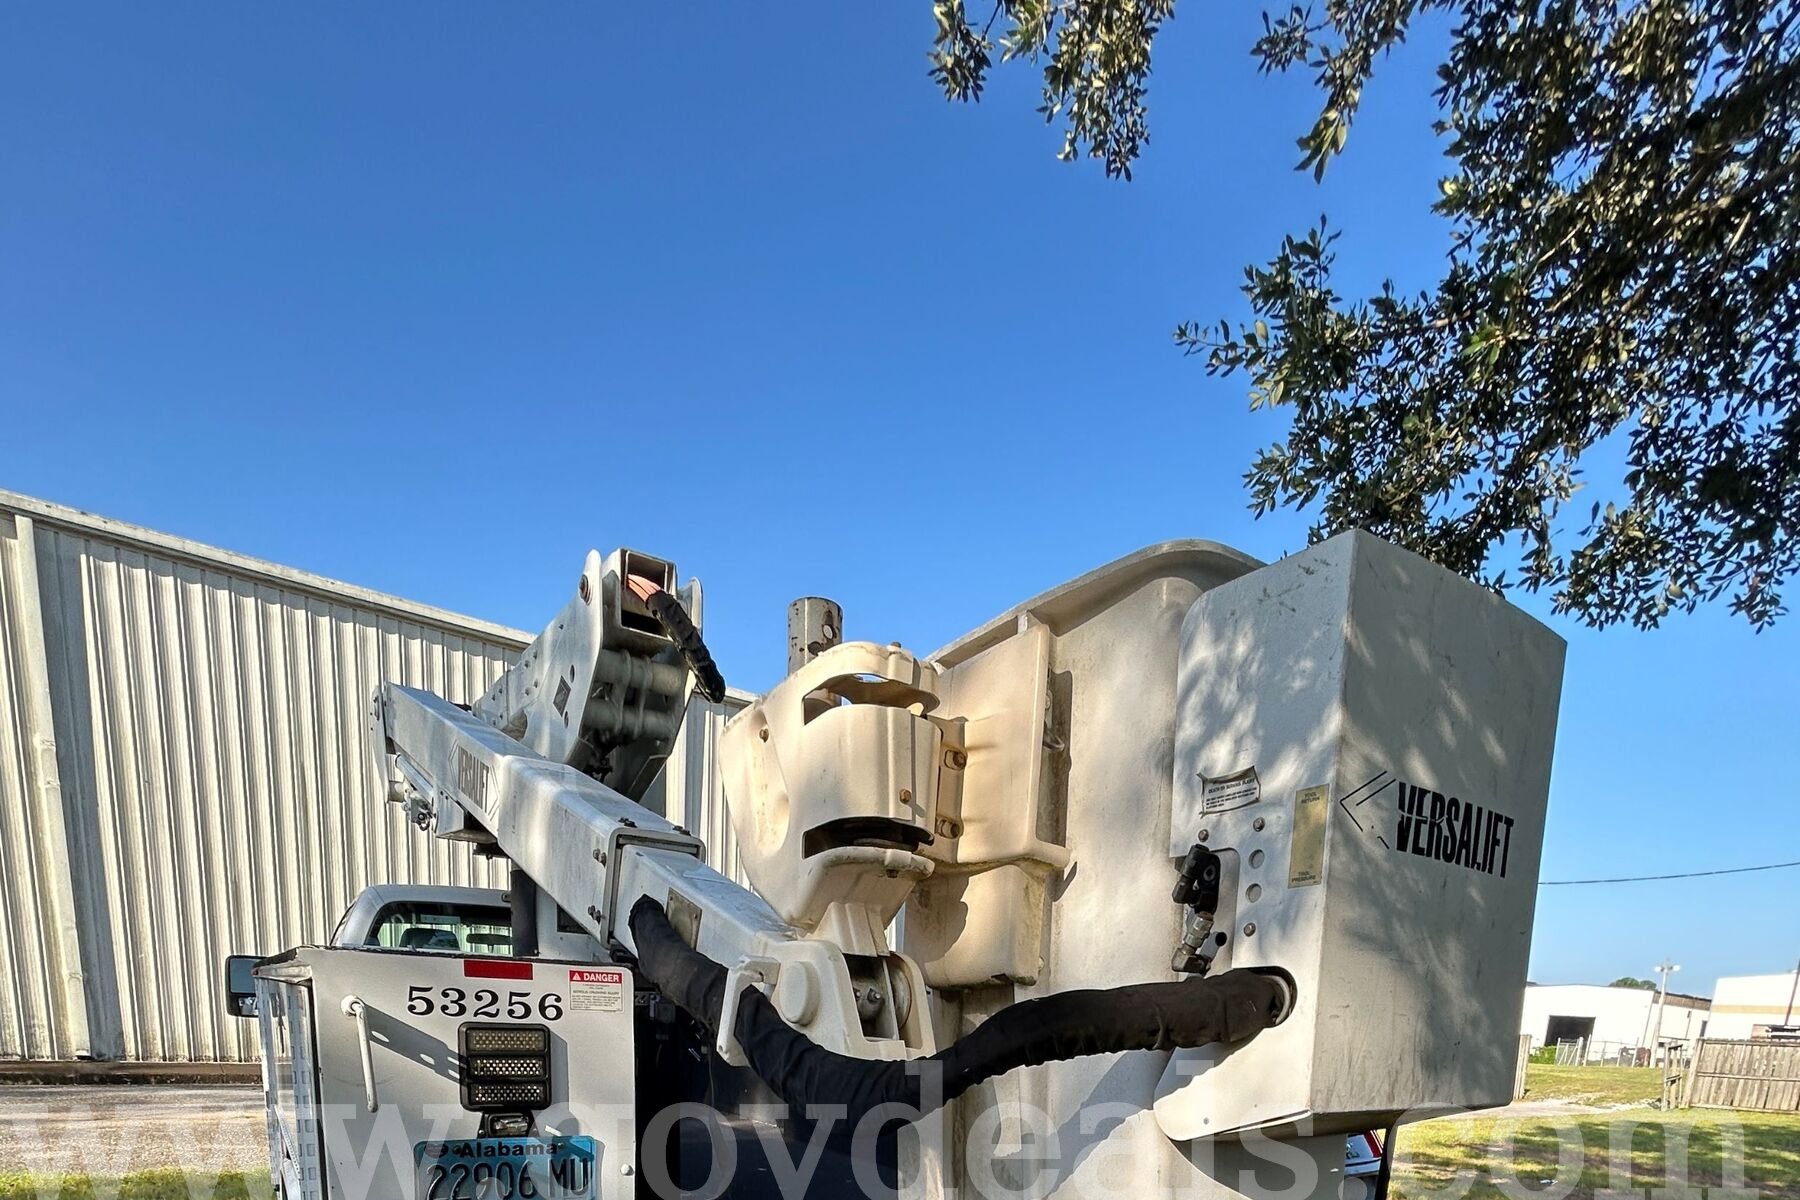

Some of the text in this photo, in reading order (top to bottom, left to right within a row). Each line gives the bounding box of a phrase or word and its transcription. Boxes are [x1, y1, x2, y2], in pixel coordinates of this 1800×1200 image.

[1396, 781, 1514, 878] VERSALIFT
[583, 972, 620, 983] DANGER
[407, 985, 564, 1021] 53256
[461, 1141, 557, 1158] Alabama
[547, 1157, 592, 1199] MU
